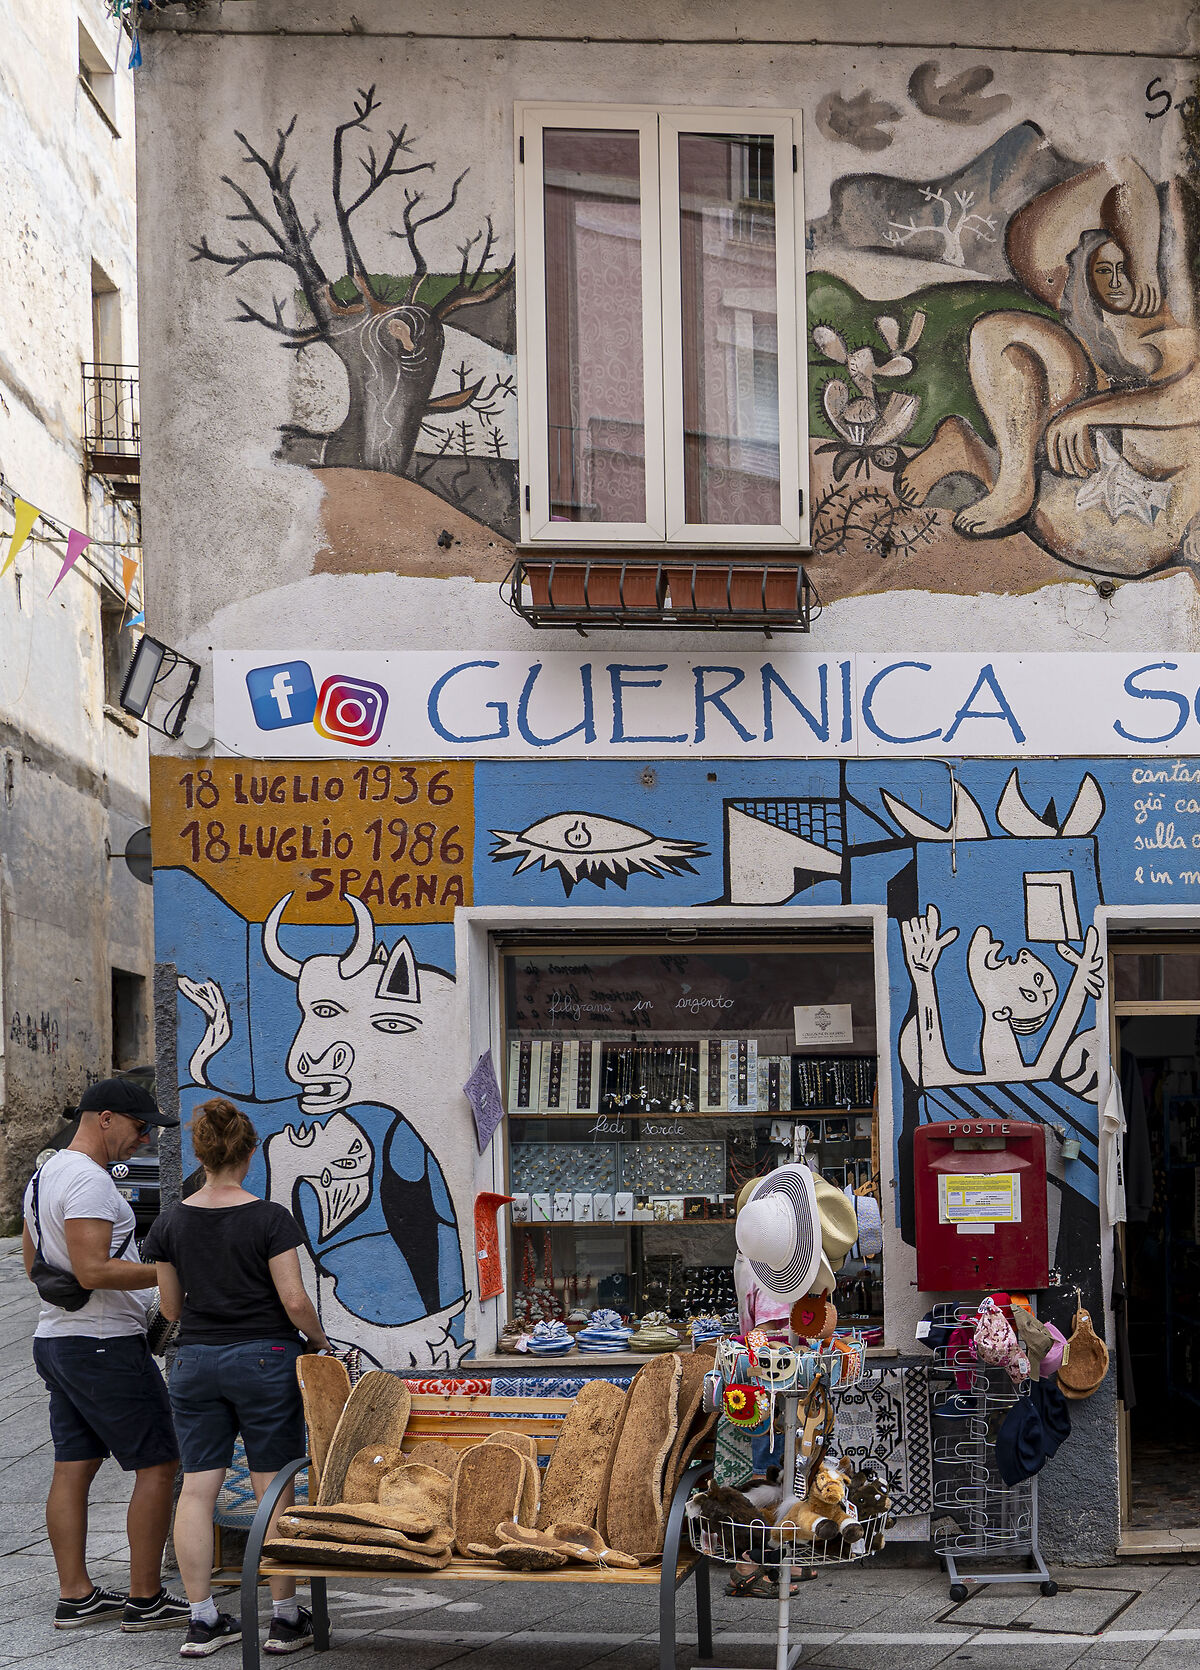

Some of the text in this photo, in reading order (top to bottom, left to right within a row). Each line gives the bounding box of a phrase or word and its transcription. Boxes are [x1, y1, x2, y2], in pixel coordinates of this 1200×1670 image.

[427, 660, 1027, 746] GUERNICA
[179, 764, 454, 809] 18 LUGLIO 1936
[179, 820, 231, 863] 18
[364, 818, 464, 867] 1986
[1134, 821, 1187, 850] sulla
[305, 868, 464, 910] SPAGNA
[1150, 864, 1173, 885] in
[548, 991, 614, 1026] filigrana
[632, 999, 654, 1012] in
[675, 993, 735, 1014] argento
[588, 1114, 686, 1144] fedi sarde
[948, 1123, 1011, 1135] POSTE
